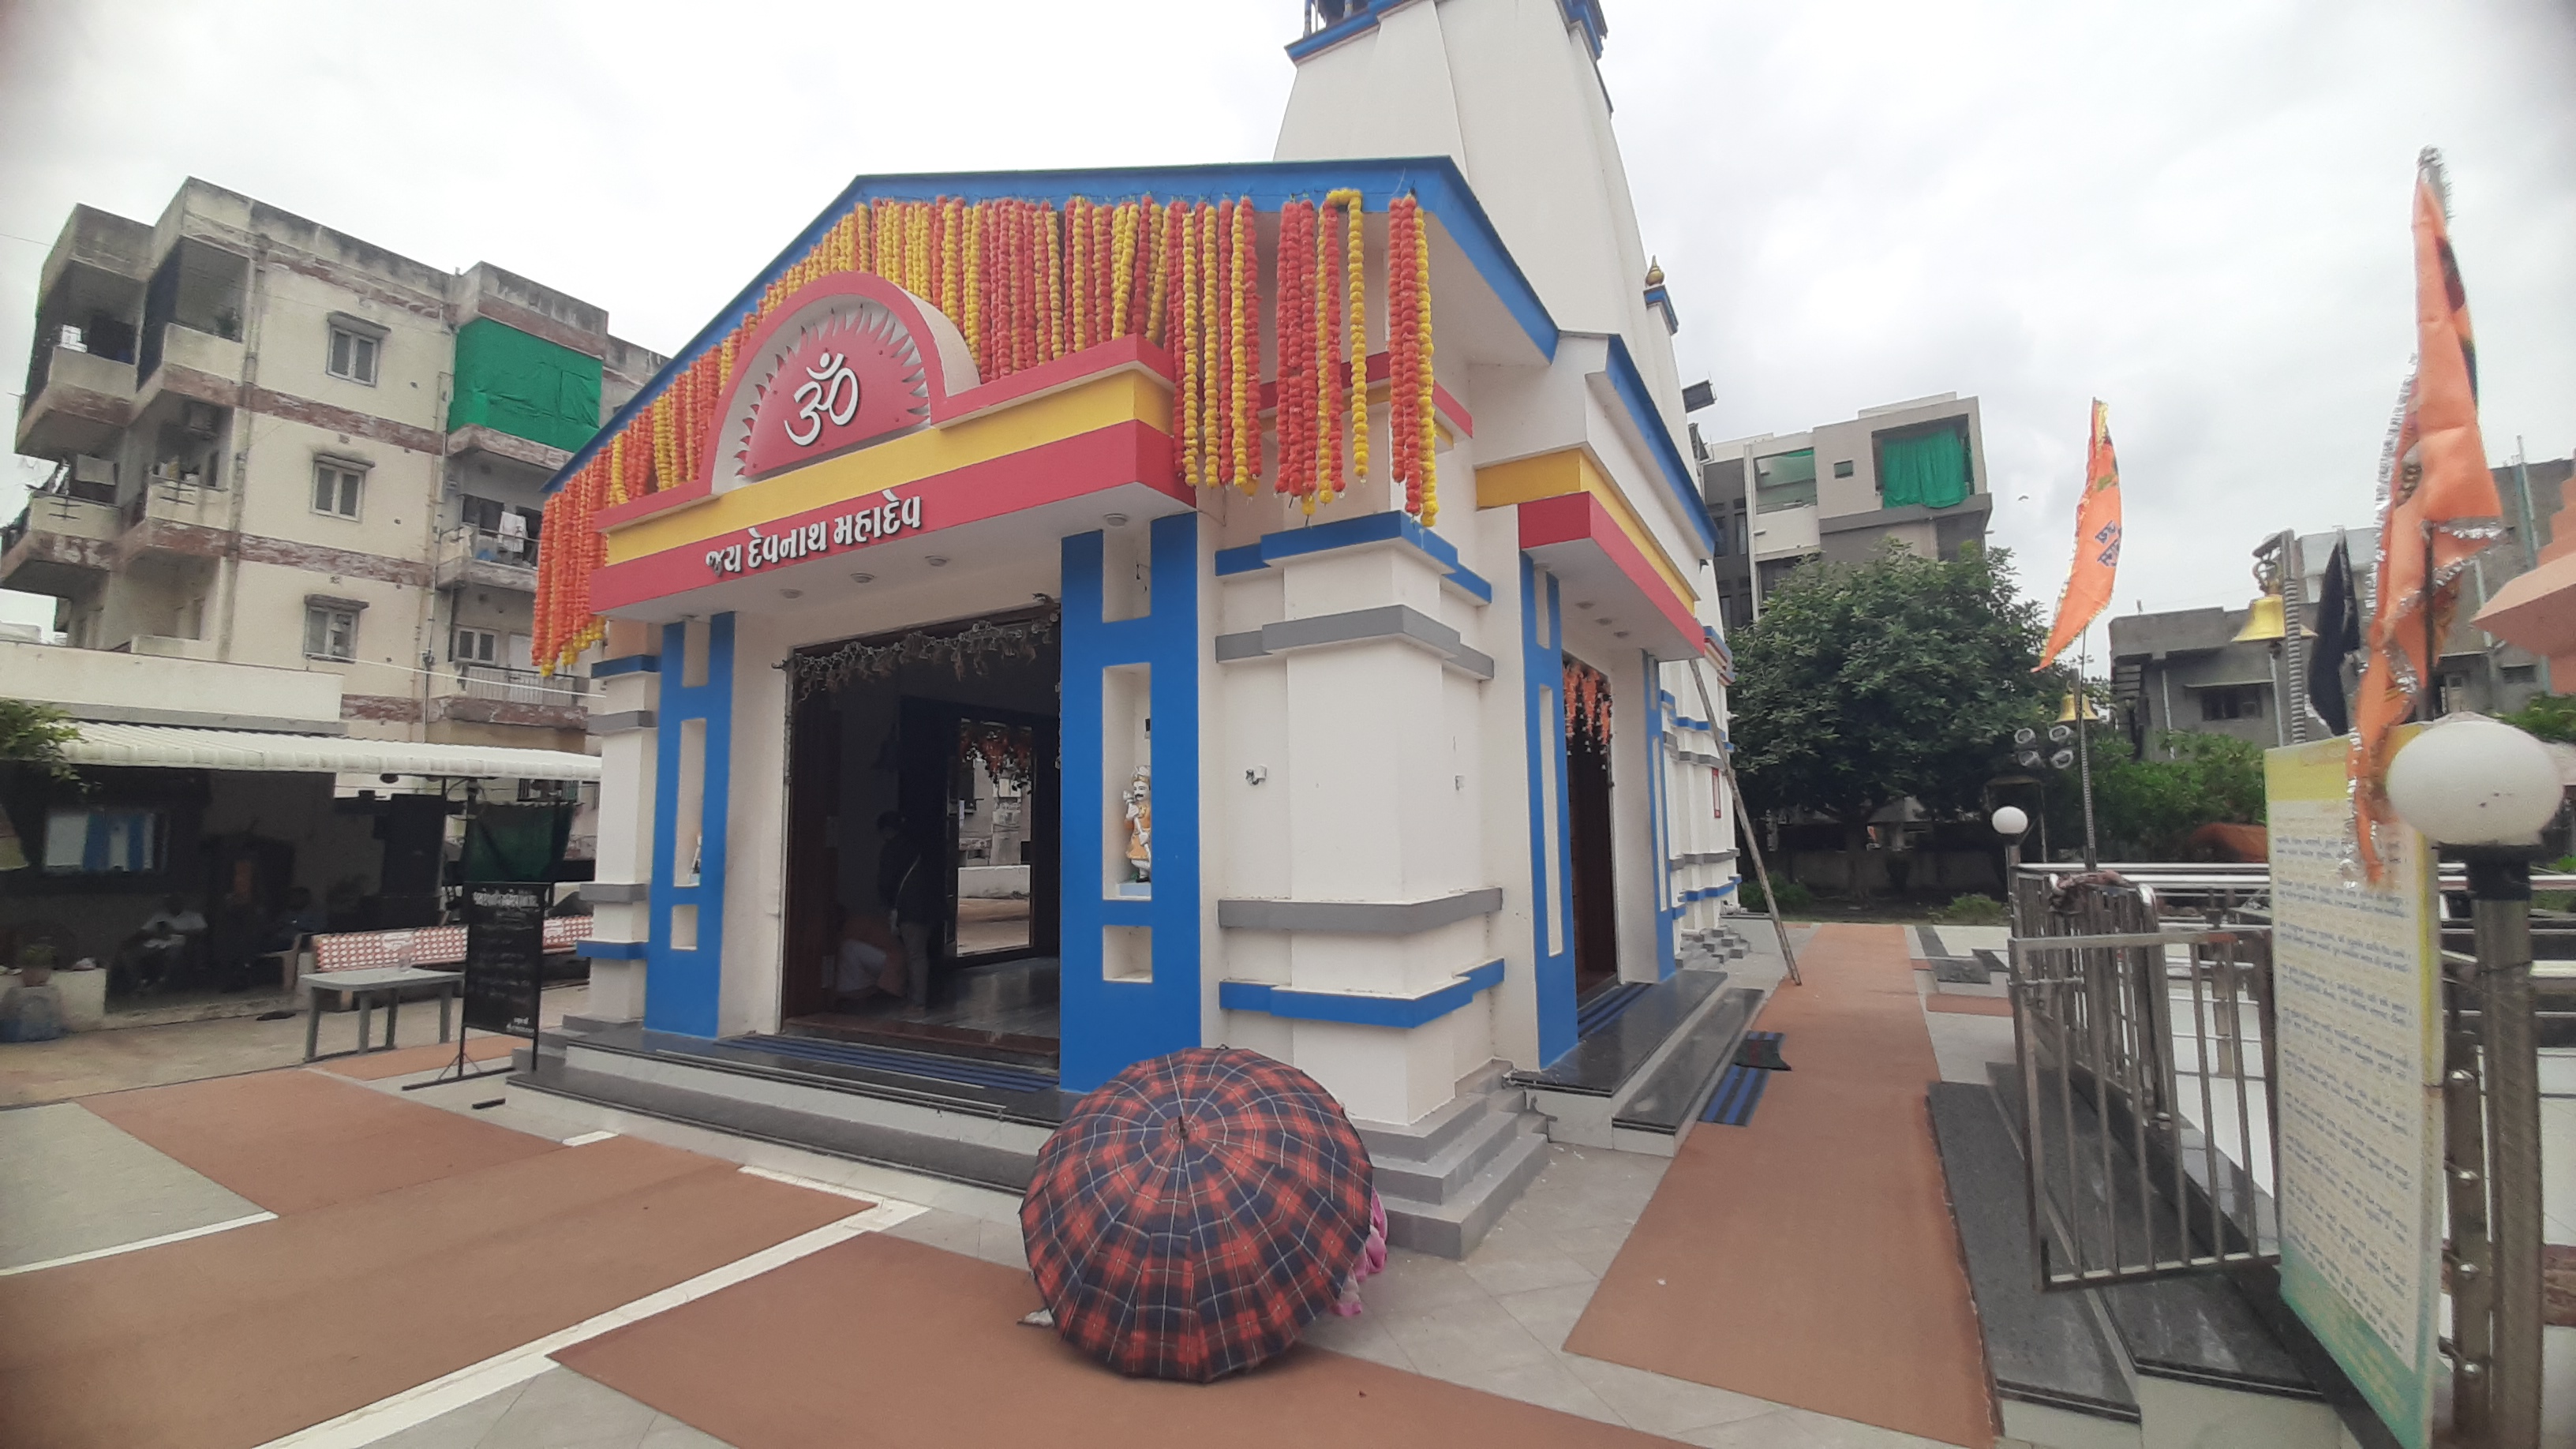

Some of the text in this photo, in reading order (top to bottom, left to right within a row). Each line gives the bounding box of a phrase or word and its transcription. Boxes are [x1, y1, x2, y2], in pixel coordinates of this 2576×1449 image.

[705, 489, 922, 576] જય દેવનાથ મહાદેવ
